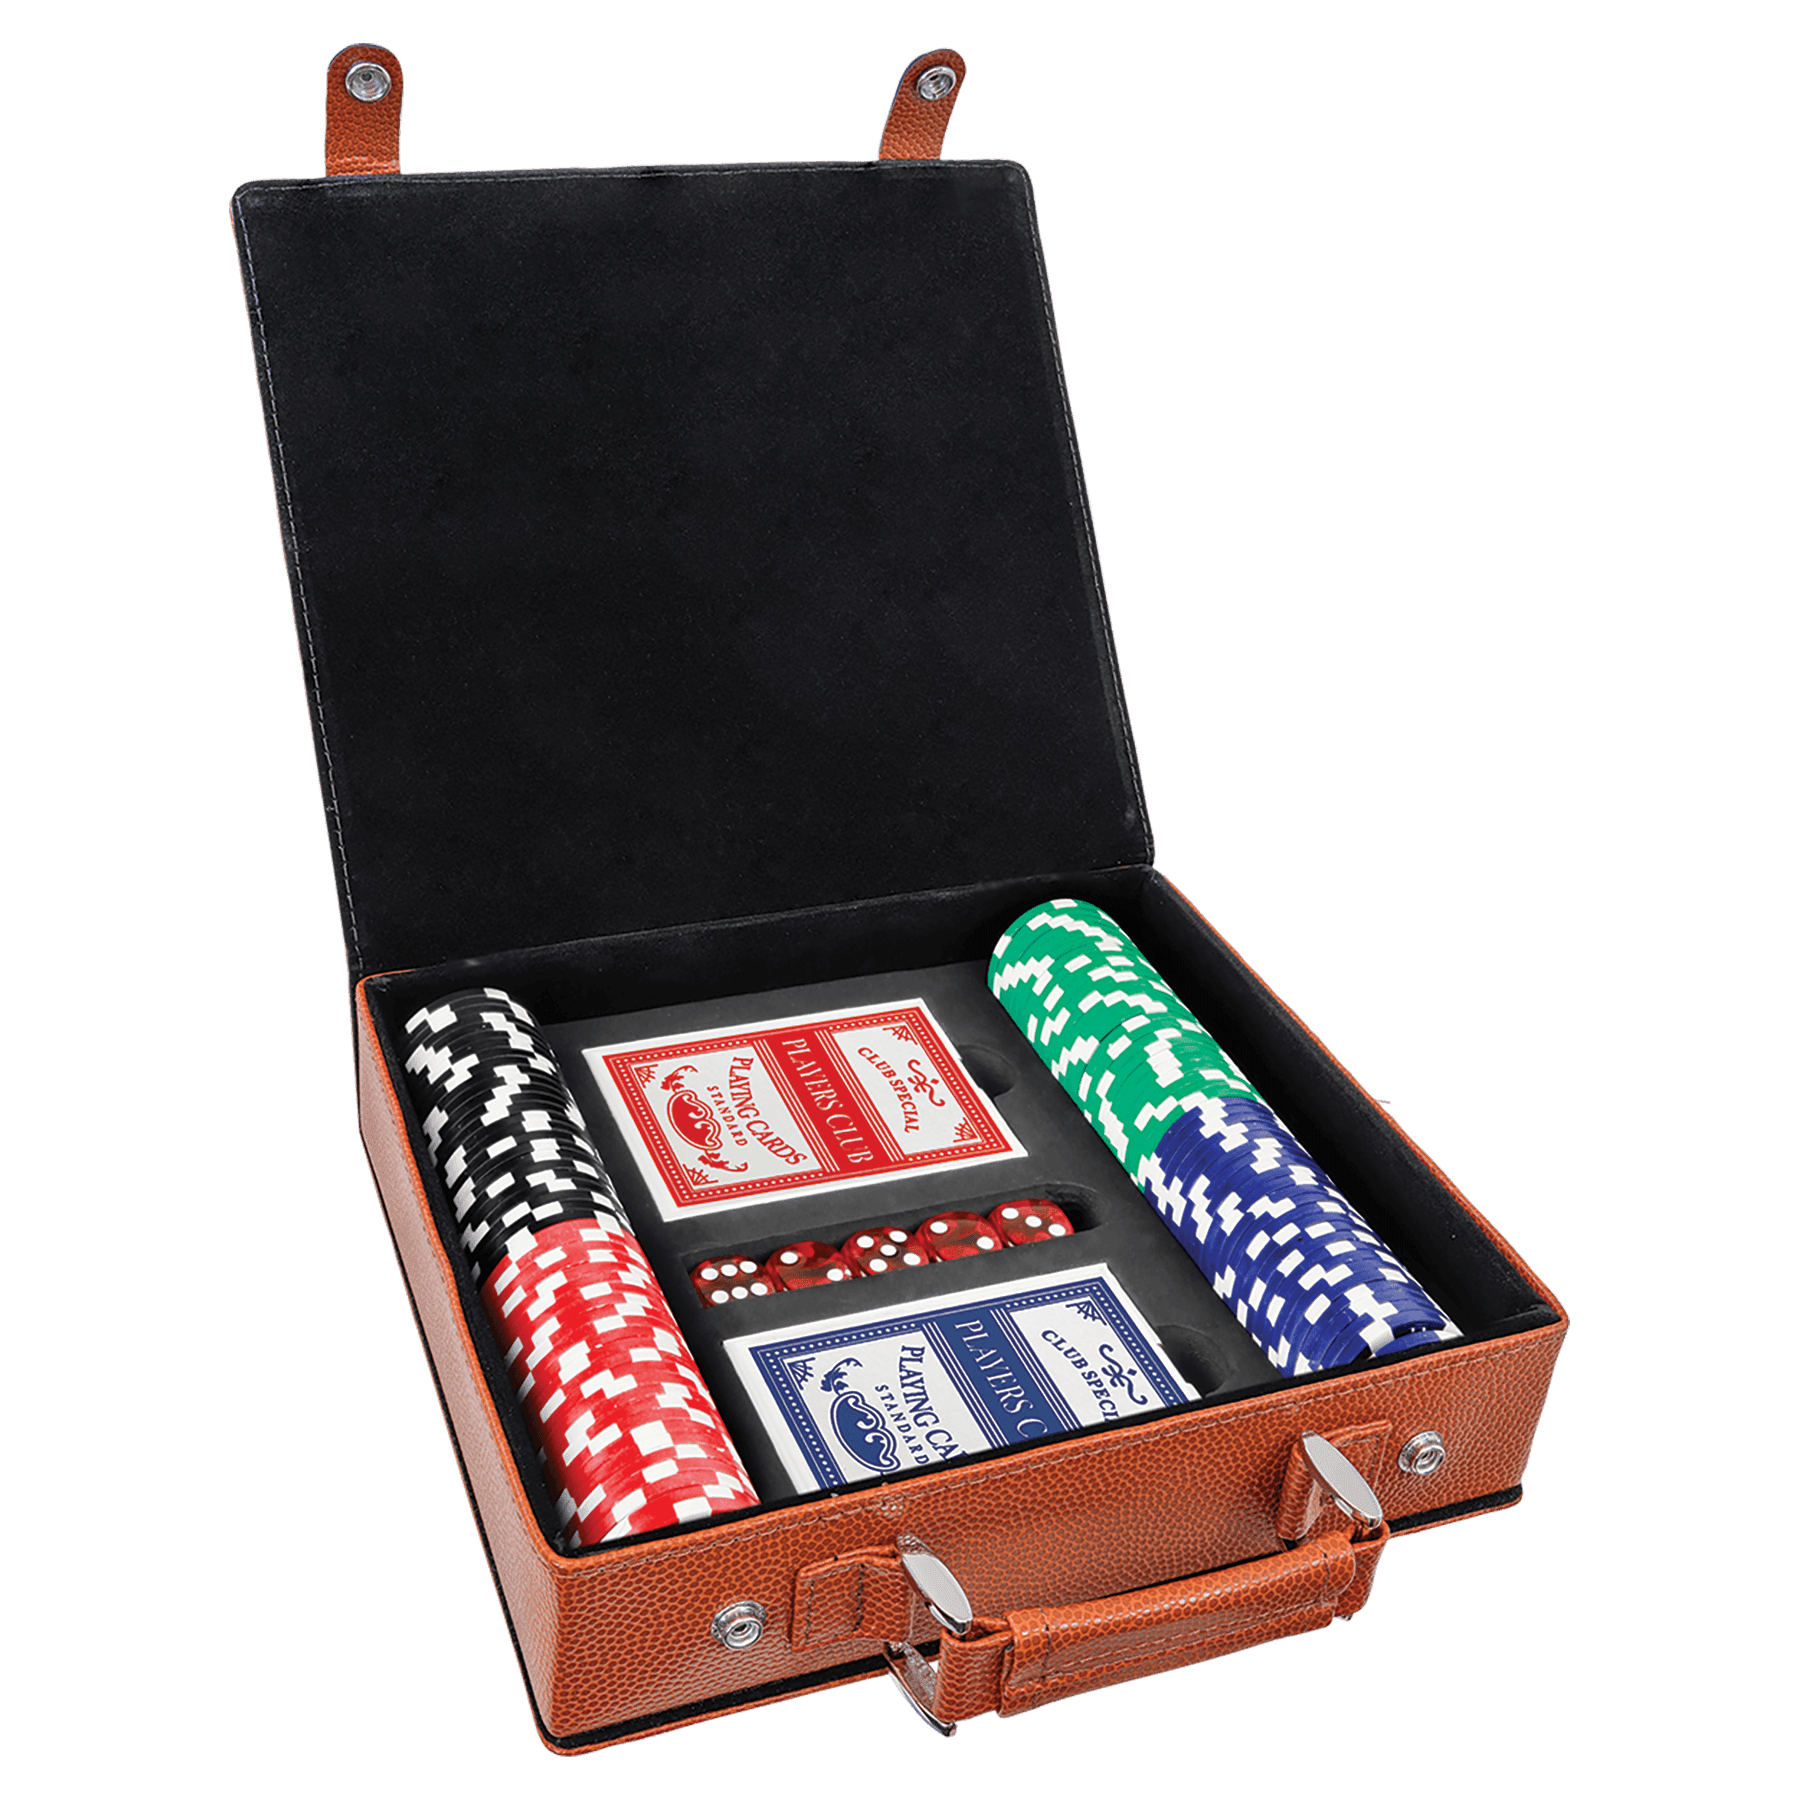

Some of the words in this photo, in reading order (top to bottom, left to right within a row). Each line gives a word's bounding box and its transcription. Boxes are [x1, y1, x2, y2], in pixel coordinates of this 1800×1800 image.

[706, 1085, 748, 1146] STANDARD
[729, 1056, 760, 1119] PLAYING
[746, 1120, 808, 1165] CARDS
[782, 1038, 843, 1111] PLAYERS
[826, 1114, 874, 1163] CLUB
[857, 1047, 897, 1078] CLUB
[889, 1078, 919, 1133] SPECIAL
[899, 1344, 940, 1427] PLAYING
[954, 1320, 1034, 1414] PLAYERS
[1041, 1329, 1089, 1369] CLUB
[875, 1384, 930, 1464] STANDARD
